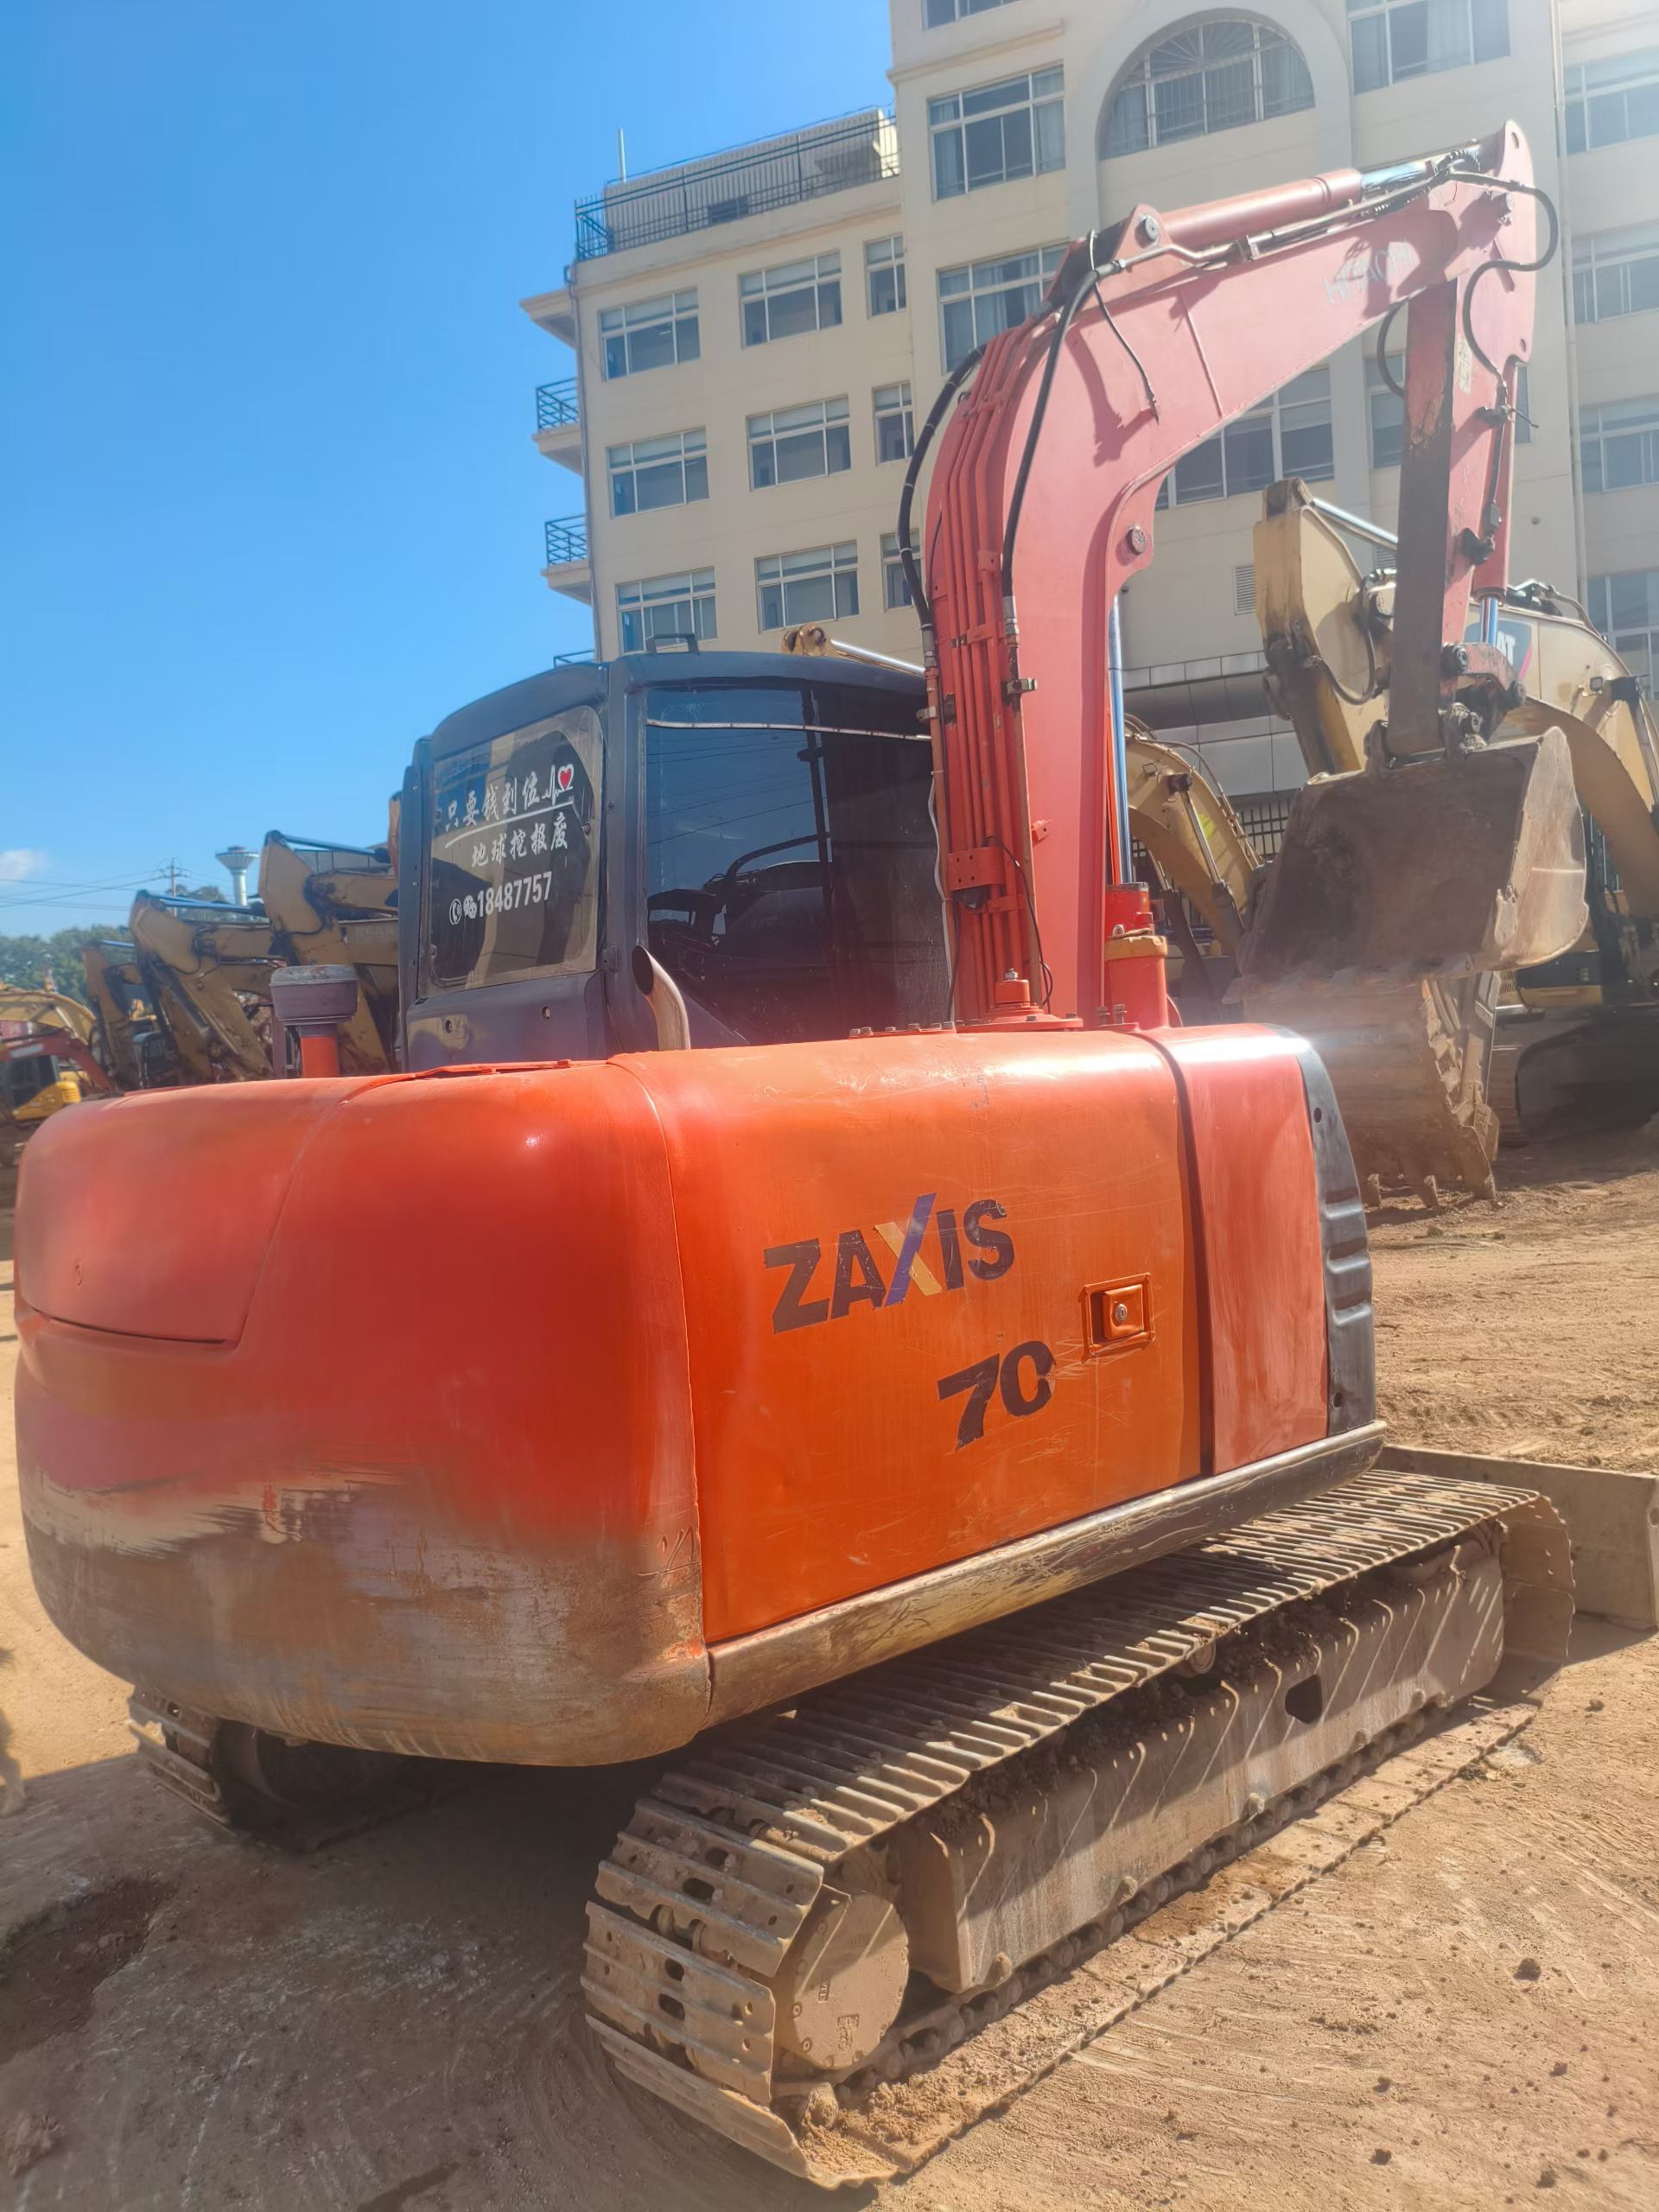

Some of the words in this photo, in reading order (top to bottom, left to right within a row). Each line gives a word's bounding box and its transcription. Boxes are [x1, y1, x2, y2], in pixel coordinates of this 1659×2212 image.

[477, 871, 553, 917] 18487757
[764, 1192, 1014, 1334] ZAXIS
[937, 1340, 1056, 1452] 70
